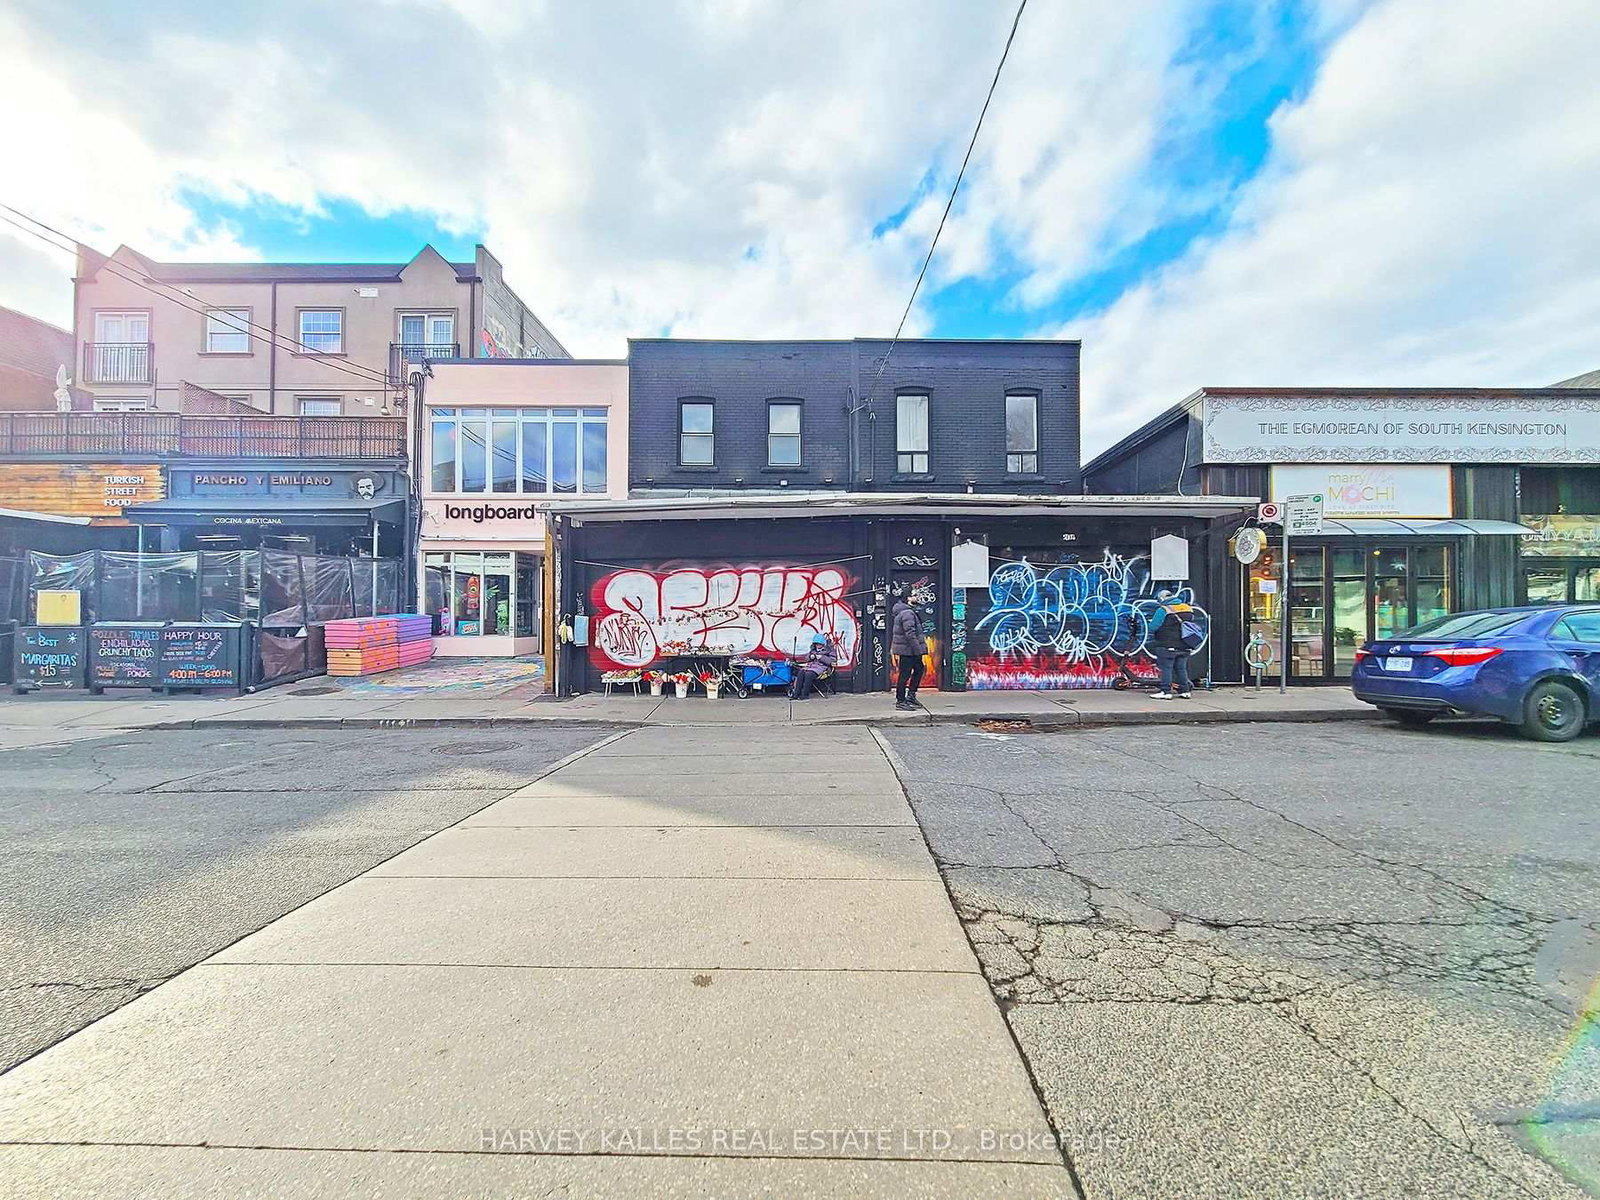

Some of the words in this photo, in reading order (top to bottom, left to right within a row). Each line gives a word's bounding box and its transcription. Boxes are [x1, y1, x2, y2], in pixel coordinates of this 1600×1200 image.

[1258, 422, 1289, 435] THE
[1293, 422, 1379, 435] EGMOREAN
[1383, 422, 1405, 435] OF
[1408, 422, 1463, 435] SOUTH
[1466, 422, 1568, 436] KENSINGTON
[104, 475, 146, 485] TURKISH
[194, 474, 248, 486] PANCHO
[255, 475, 264, 486] Y
[271, 475, 333, 487] EMILIANO
[104, 487, 138, 496] STREET
[1328, 485, 1395, 503] MOCHI
[104, 499, 132, 507] FOOD
[445, 504, 535, 523] longboard
[214, 517, 243, 525] COCINA
[245, 517, 283, 525] MEXICANA
[164, 631, 194, 640] HAPPY
[197, 631, 222, 641] HOUR
[100, 639, 151, 648] ENCHILADAS
[98, 648, 131, 657] CRUNCHY
[131, 647, 155, 658] TACOS
[21, 653, 77, 667] MARGARITAS
[39, 664, 57, 677] $15
[222, 670, 233, 678] PM
